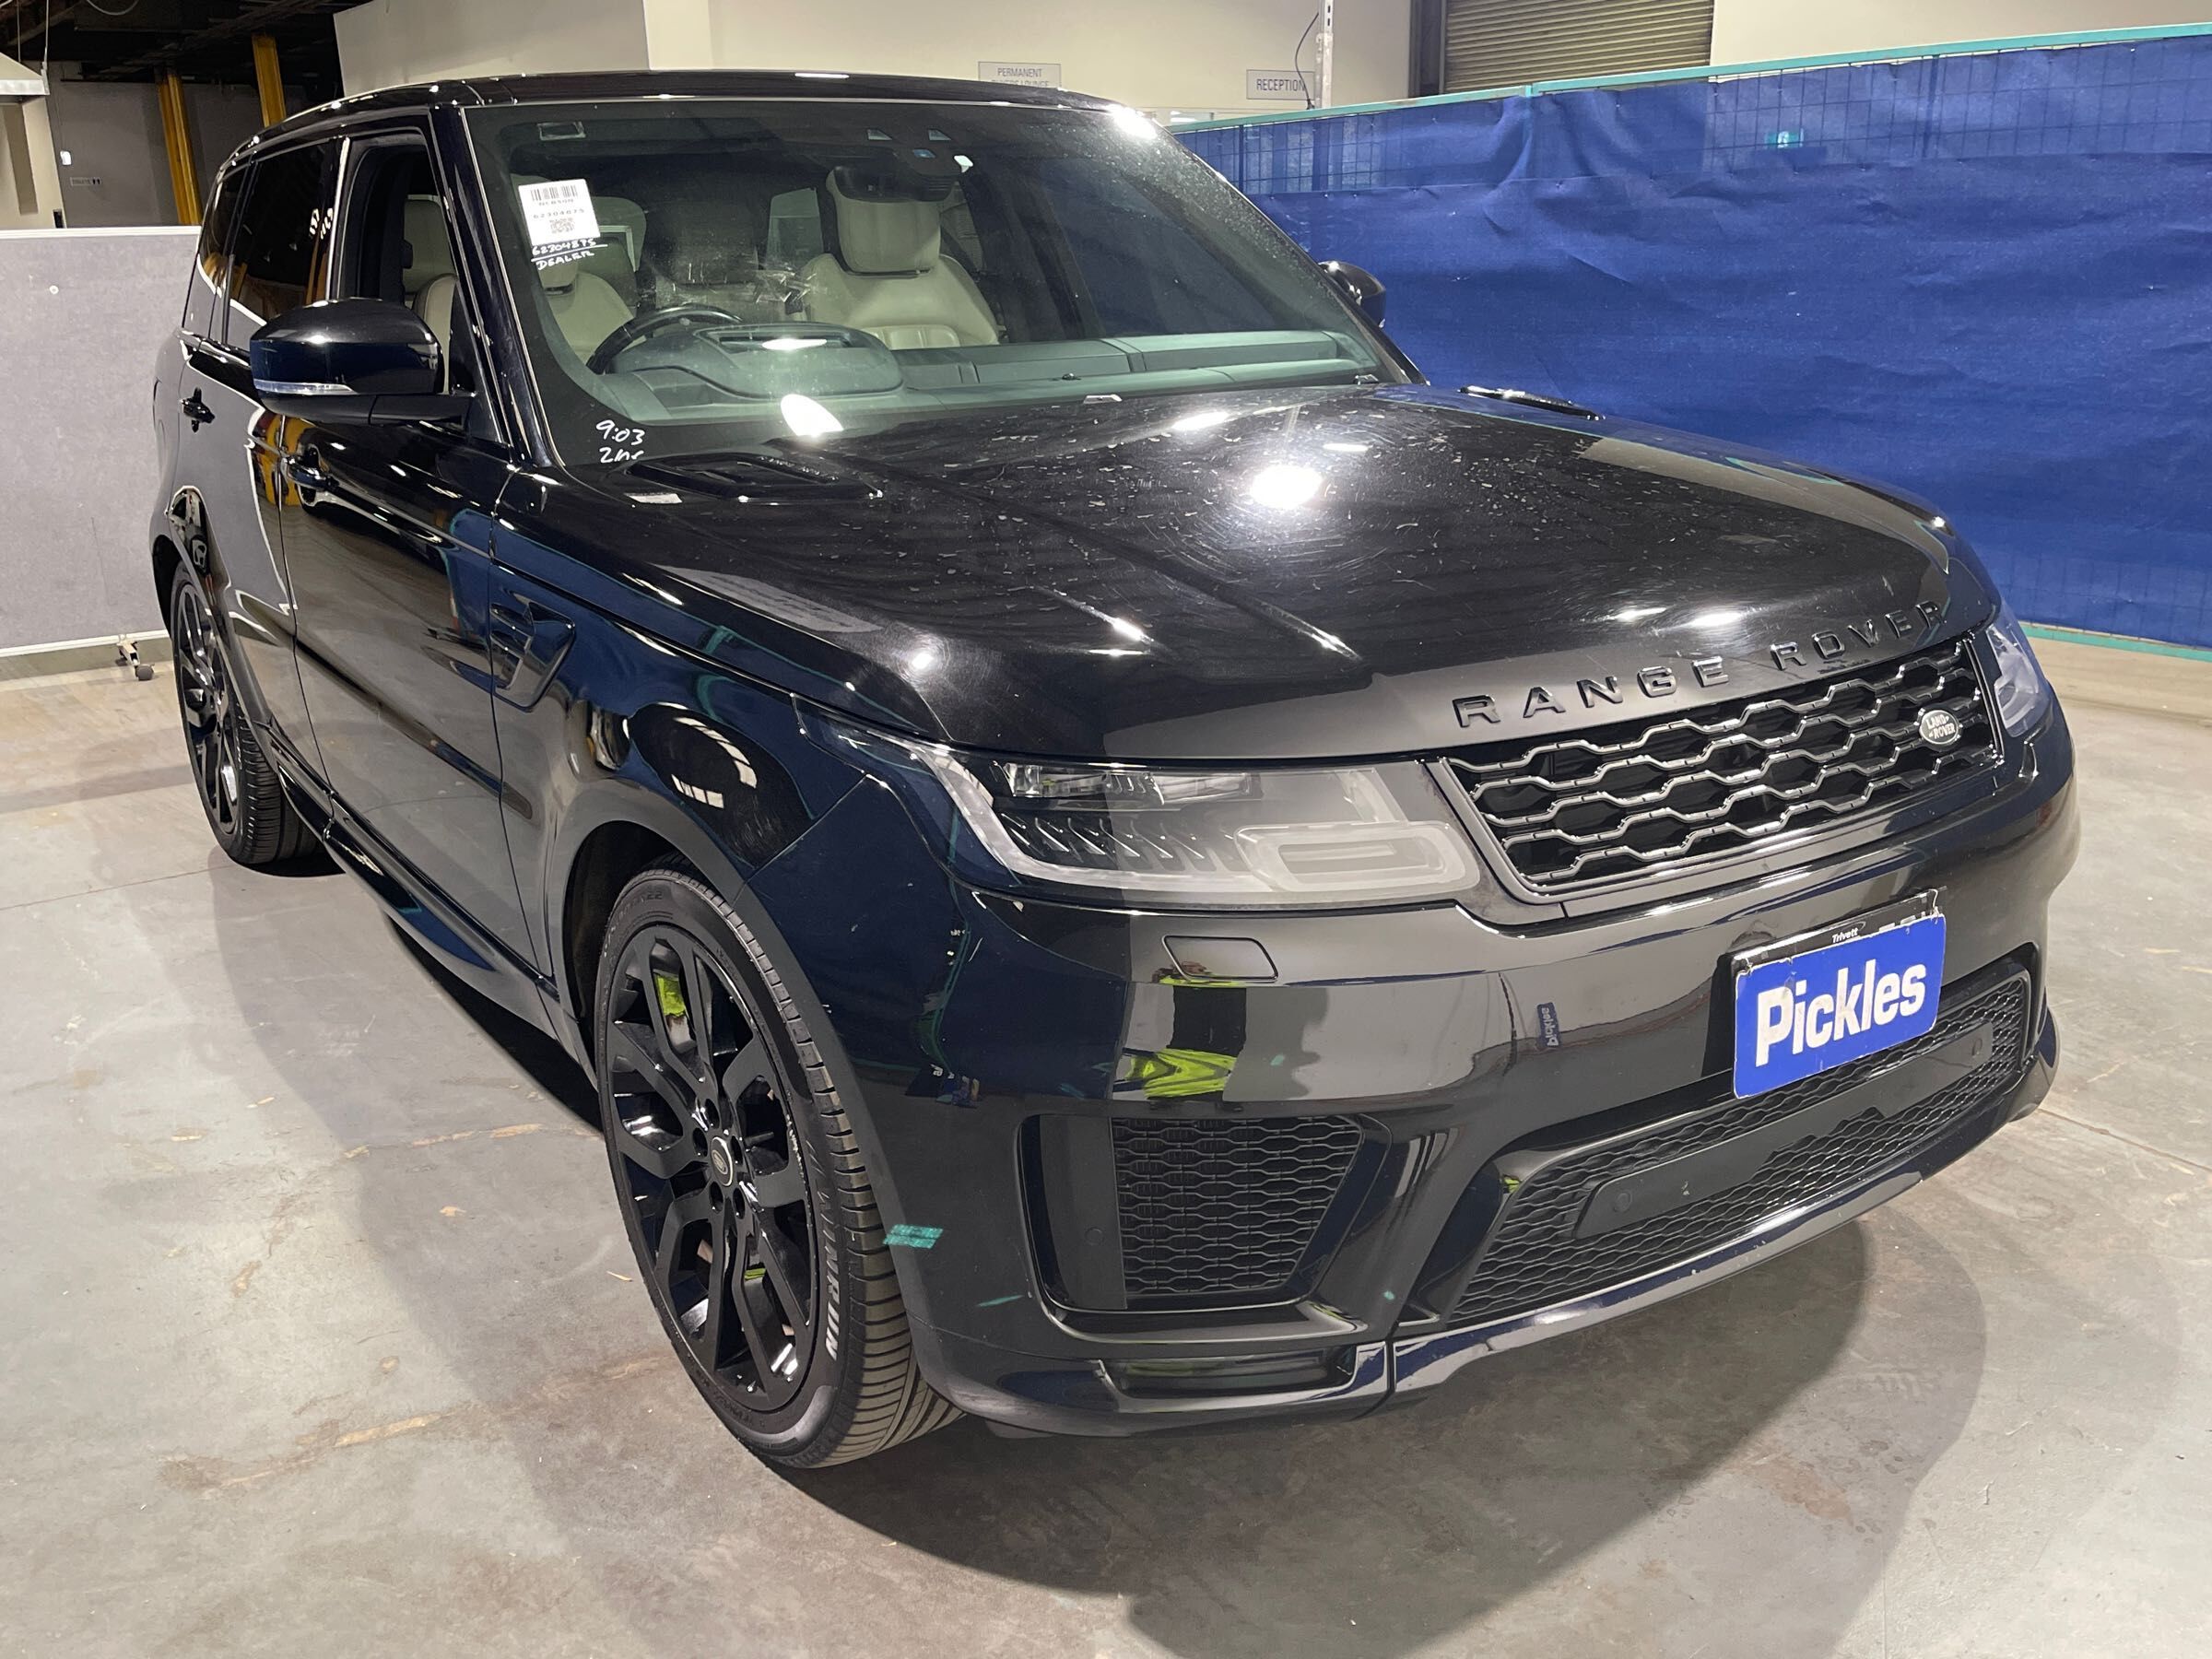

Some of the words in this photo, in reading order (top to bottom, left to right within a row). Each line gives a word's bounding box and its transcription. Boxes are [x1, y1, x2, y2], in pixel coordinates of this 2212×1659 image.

[997, 67, 1042, 77] PERMANENT
[1256, 78, 1305, 91] RECEPTION
[535, 250, 594, 270] DEALER
[595, 419, 645, 445] 9:03
[1453, 655, 1729, 728] RANGE
[1770, 600, 1947, 671] ROVER
[1925, 714, 1947, 729] LAND
[1933, 723, 1956, 739] ROVER
[1755, 959, 1926, 1067] Pickles
